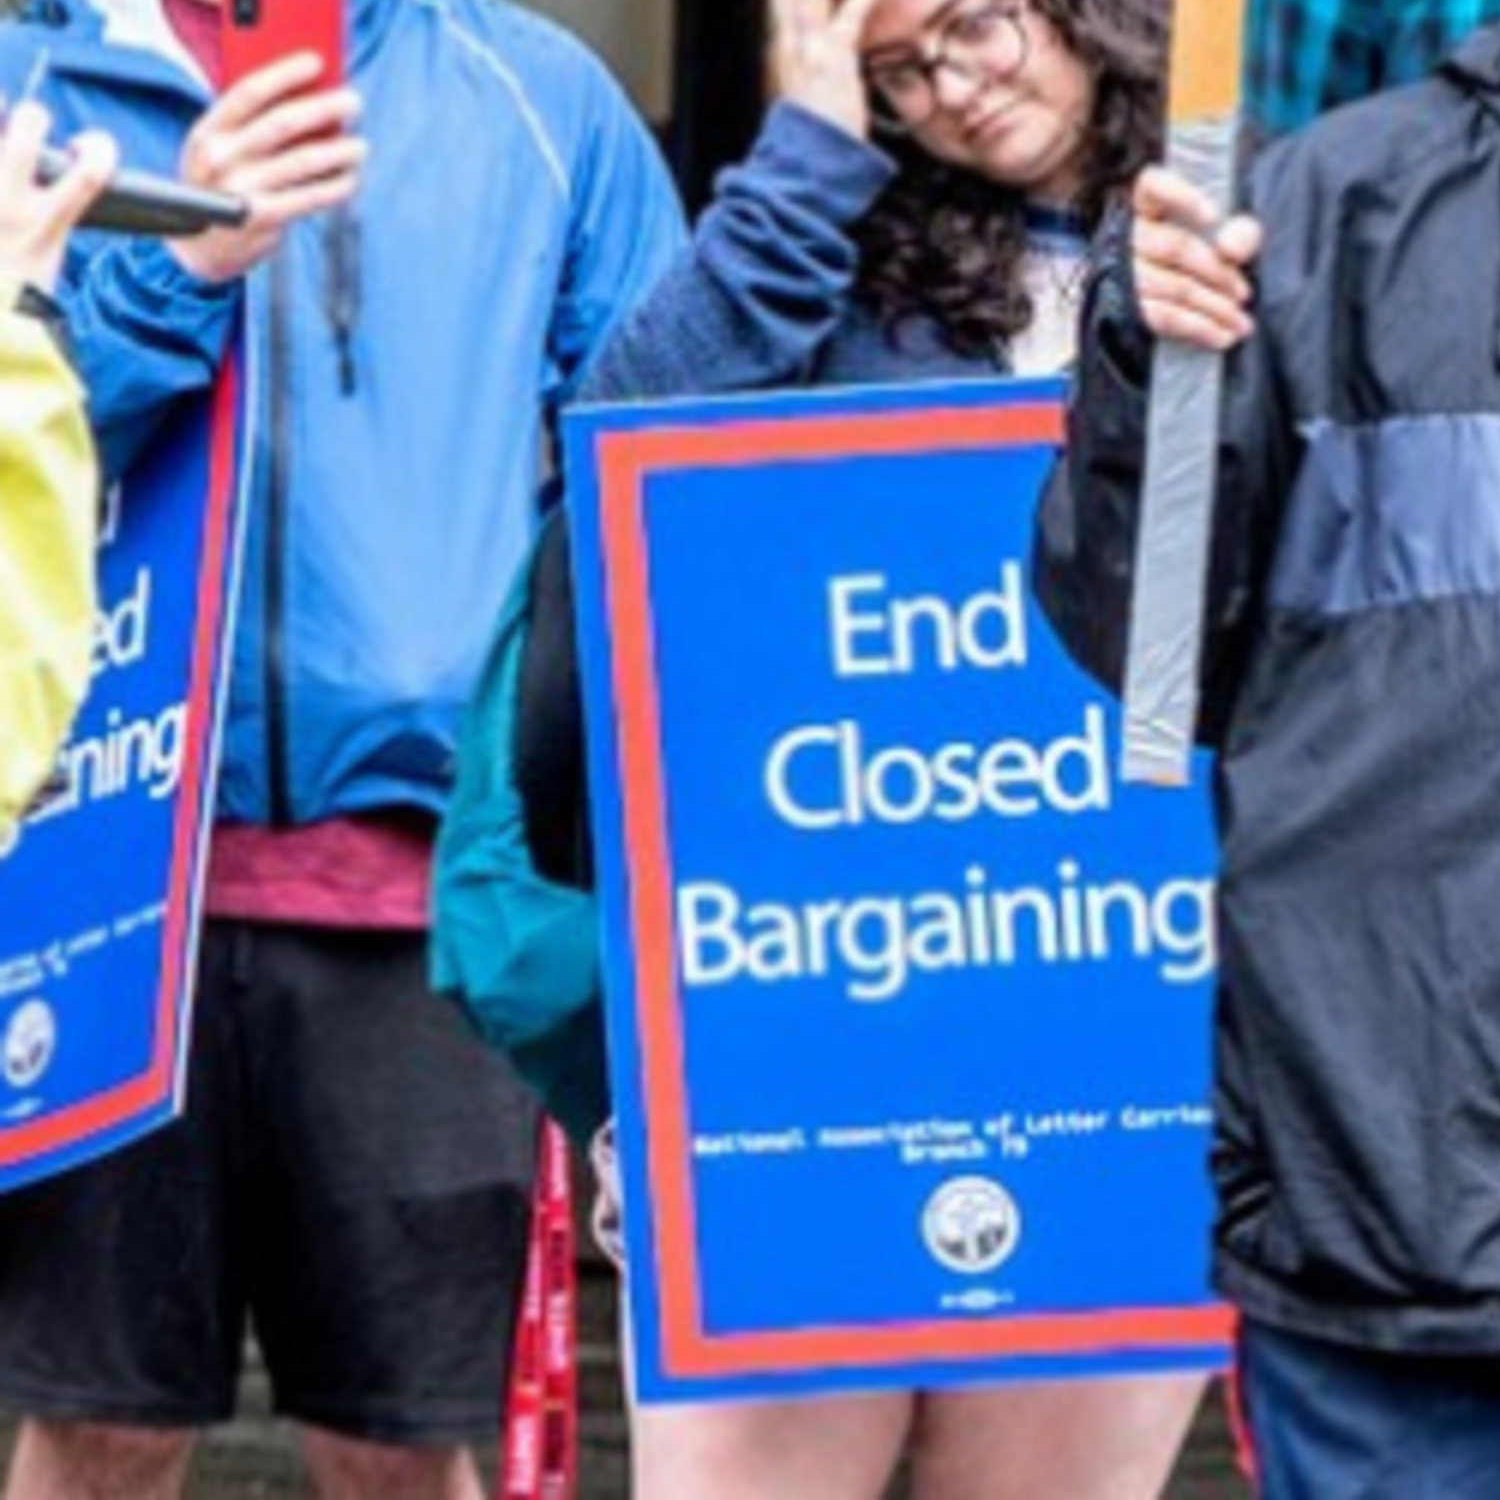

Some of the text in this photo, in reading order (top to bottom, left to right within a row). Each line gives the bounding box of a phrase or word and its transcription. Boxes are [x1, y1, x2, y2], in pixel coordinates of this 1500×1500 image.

[827, 558, 1027, 676] End
[764, 702, 1112, 829] Closed
[676, 857, 1218, 1001] Bargaining
